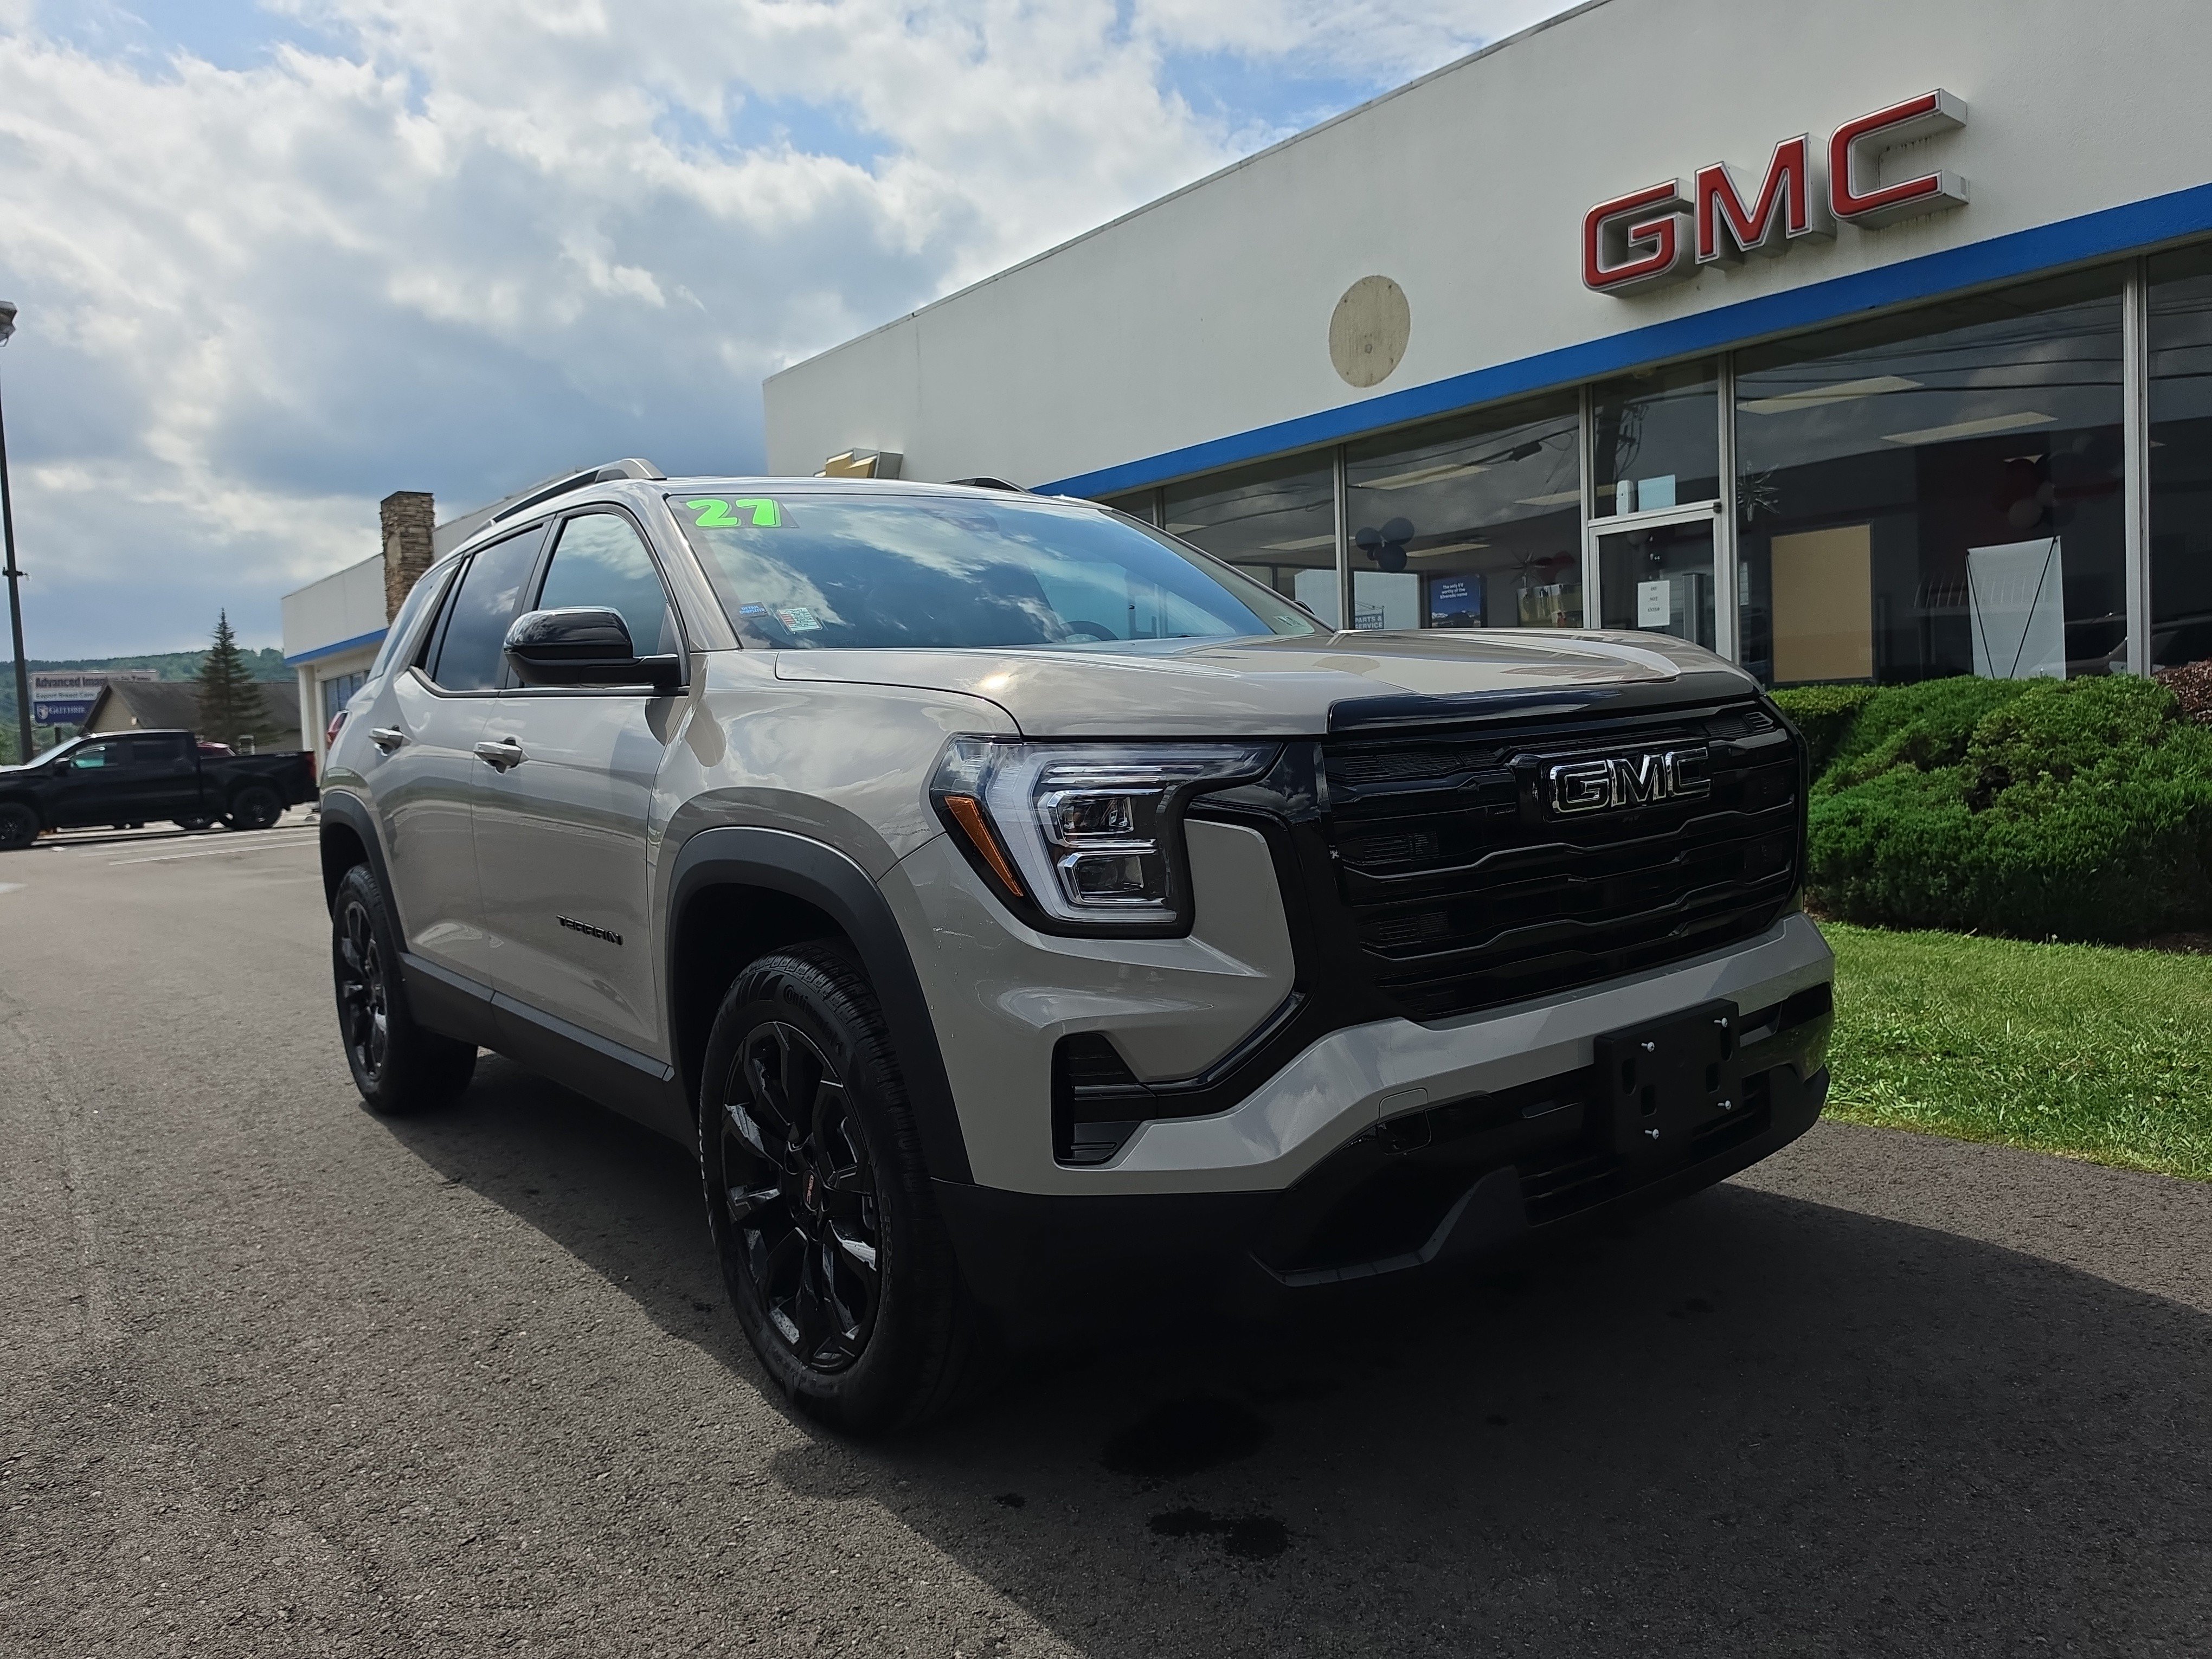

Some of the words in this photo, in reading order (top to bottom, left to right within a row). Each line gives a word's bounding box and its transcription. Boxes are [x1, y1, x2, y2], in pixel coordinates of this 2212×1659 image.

[1582, 88, 1945, 293] GMC
[686, 498, 781, 528] 27
[36, 677, 81, 687] Advanced
[1549, 747, 1712, 813] GMC
[556, 914, 623, 946] TERRAIN
[782, 983, 838, 1046] Continental
